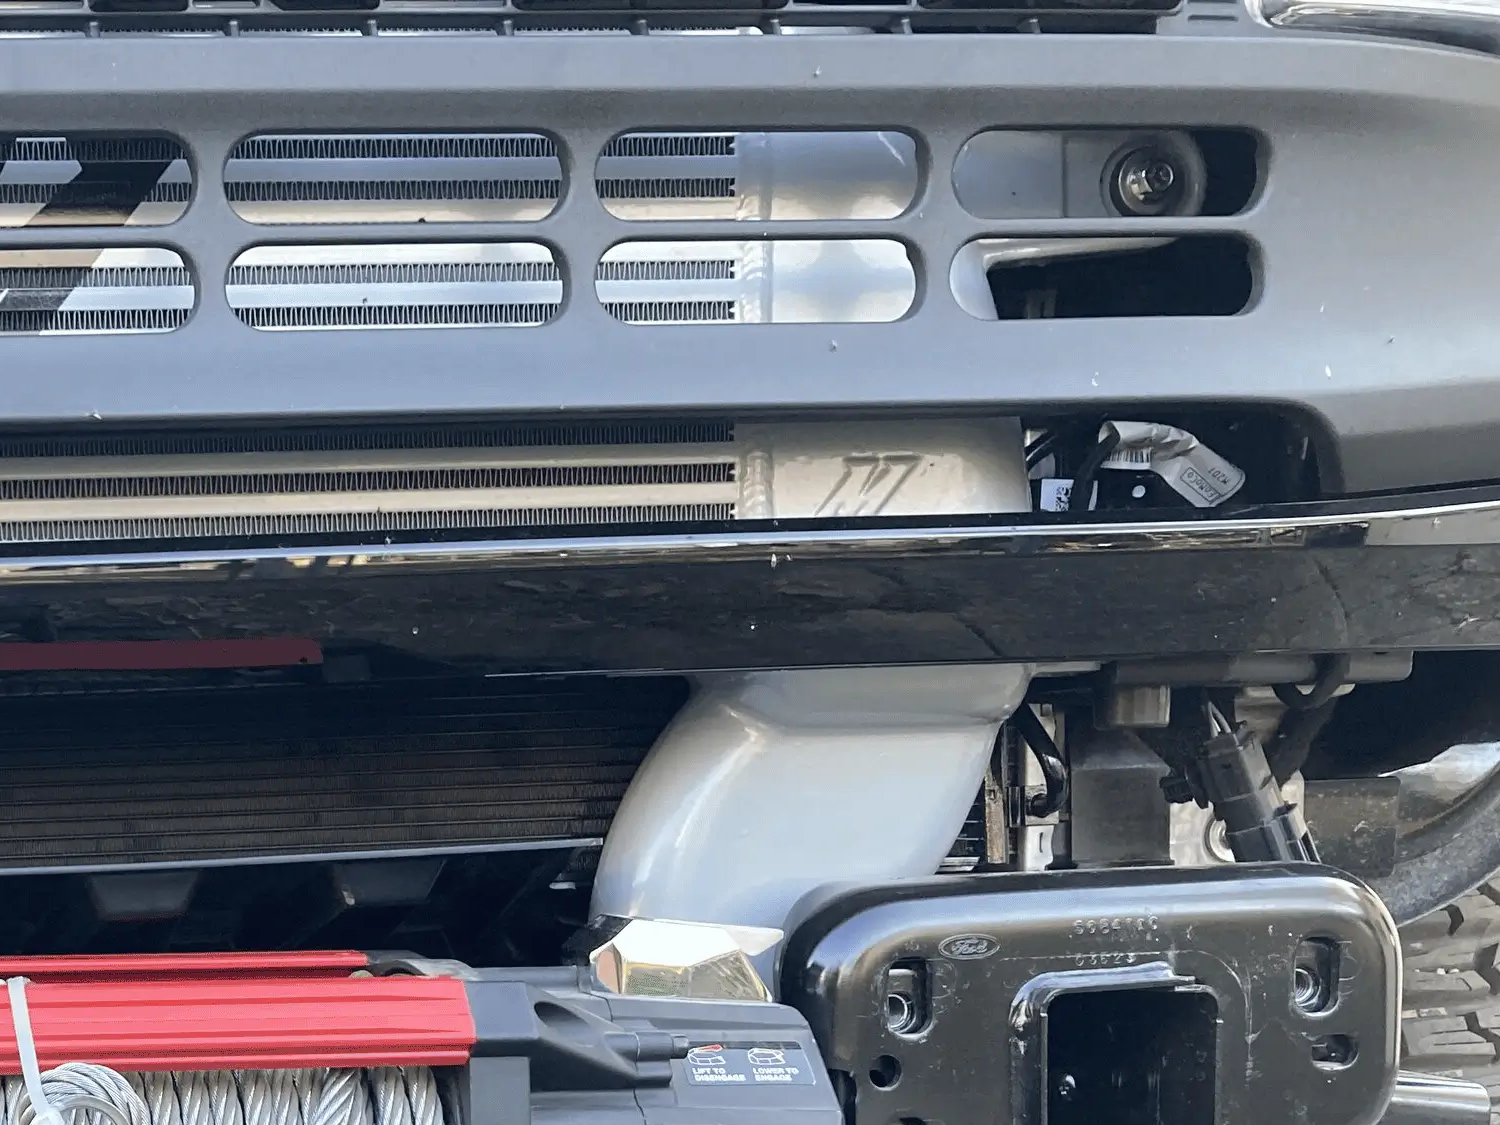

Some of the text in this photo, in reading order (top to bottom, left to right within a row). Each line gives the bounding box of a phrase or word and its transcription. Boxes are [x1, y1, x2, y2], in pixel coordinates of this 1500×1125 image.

[692, 1067, 726, 1075] LIFT TO
[752, 1067, 799, 1076] LOWER TO
[694, 1074, 747, 1082] DISENGAGE
[754, 1074, 793, 1082] ENGAGE
